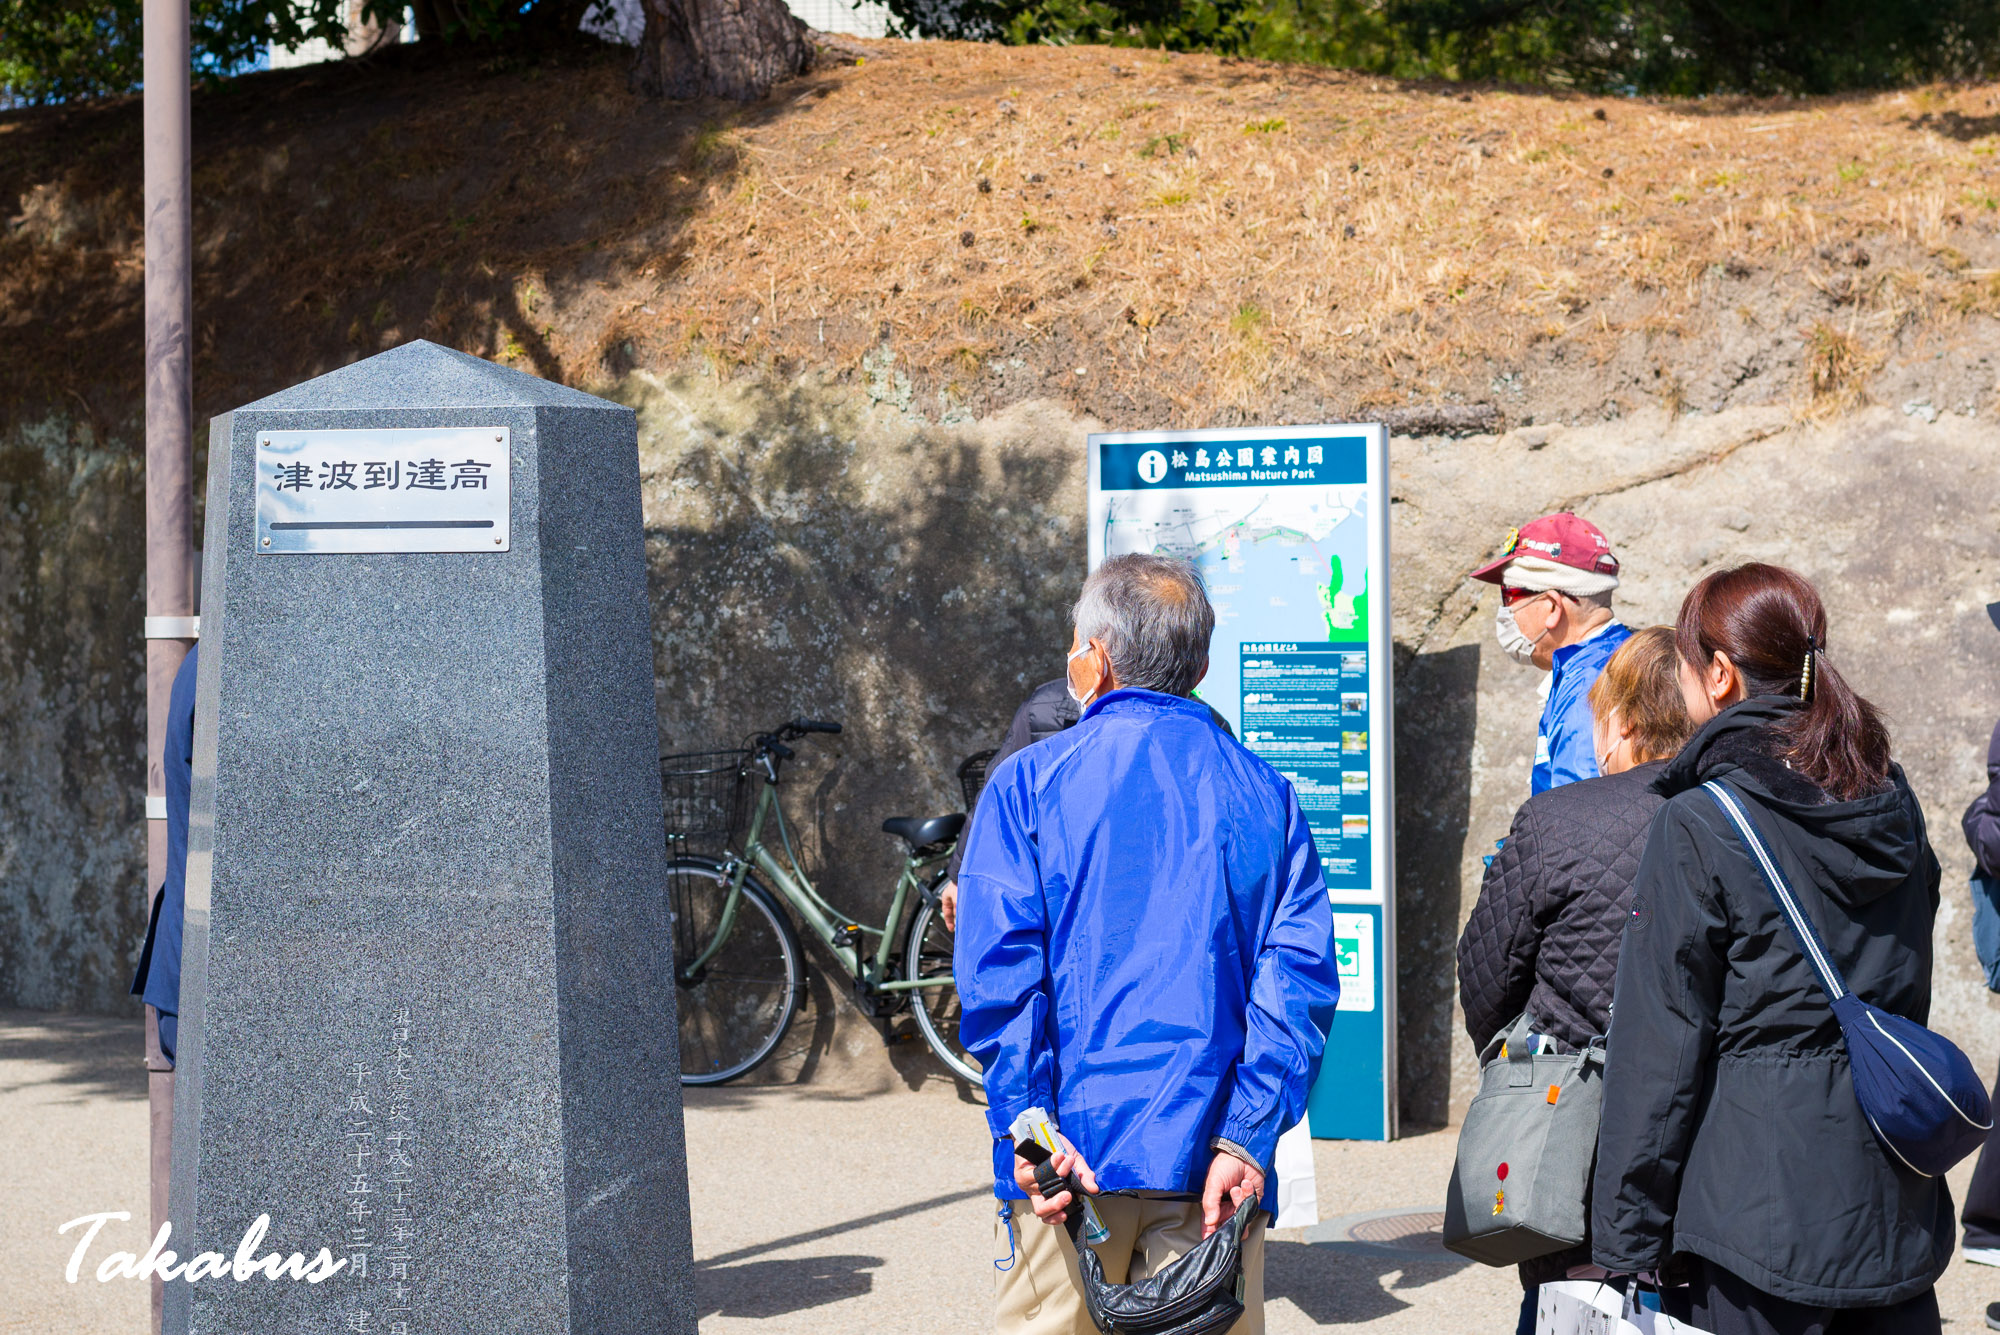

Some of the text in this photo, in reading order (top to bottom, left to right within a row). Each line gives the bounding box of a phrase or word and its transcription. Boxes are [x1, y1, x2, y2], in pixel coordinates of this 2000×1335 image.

[1171, 445, 1323, 469] 松島公園案内図
[273, 458, 492, 493] 津波到達高
[1184, 468, 1315, 482] Matsushima Nature Park
[346, 1061, 373, 1278] 平成二十五年三月
